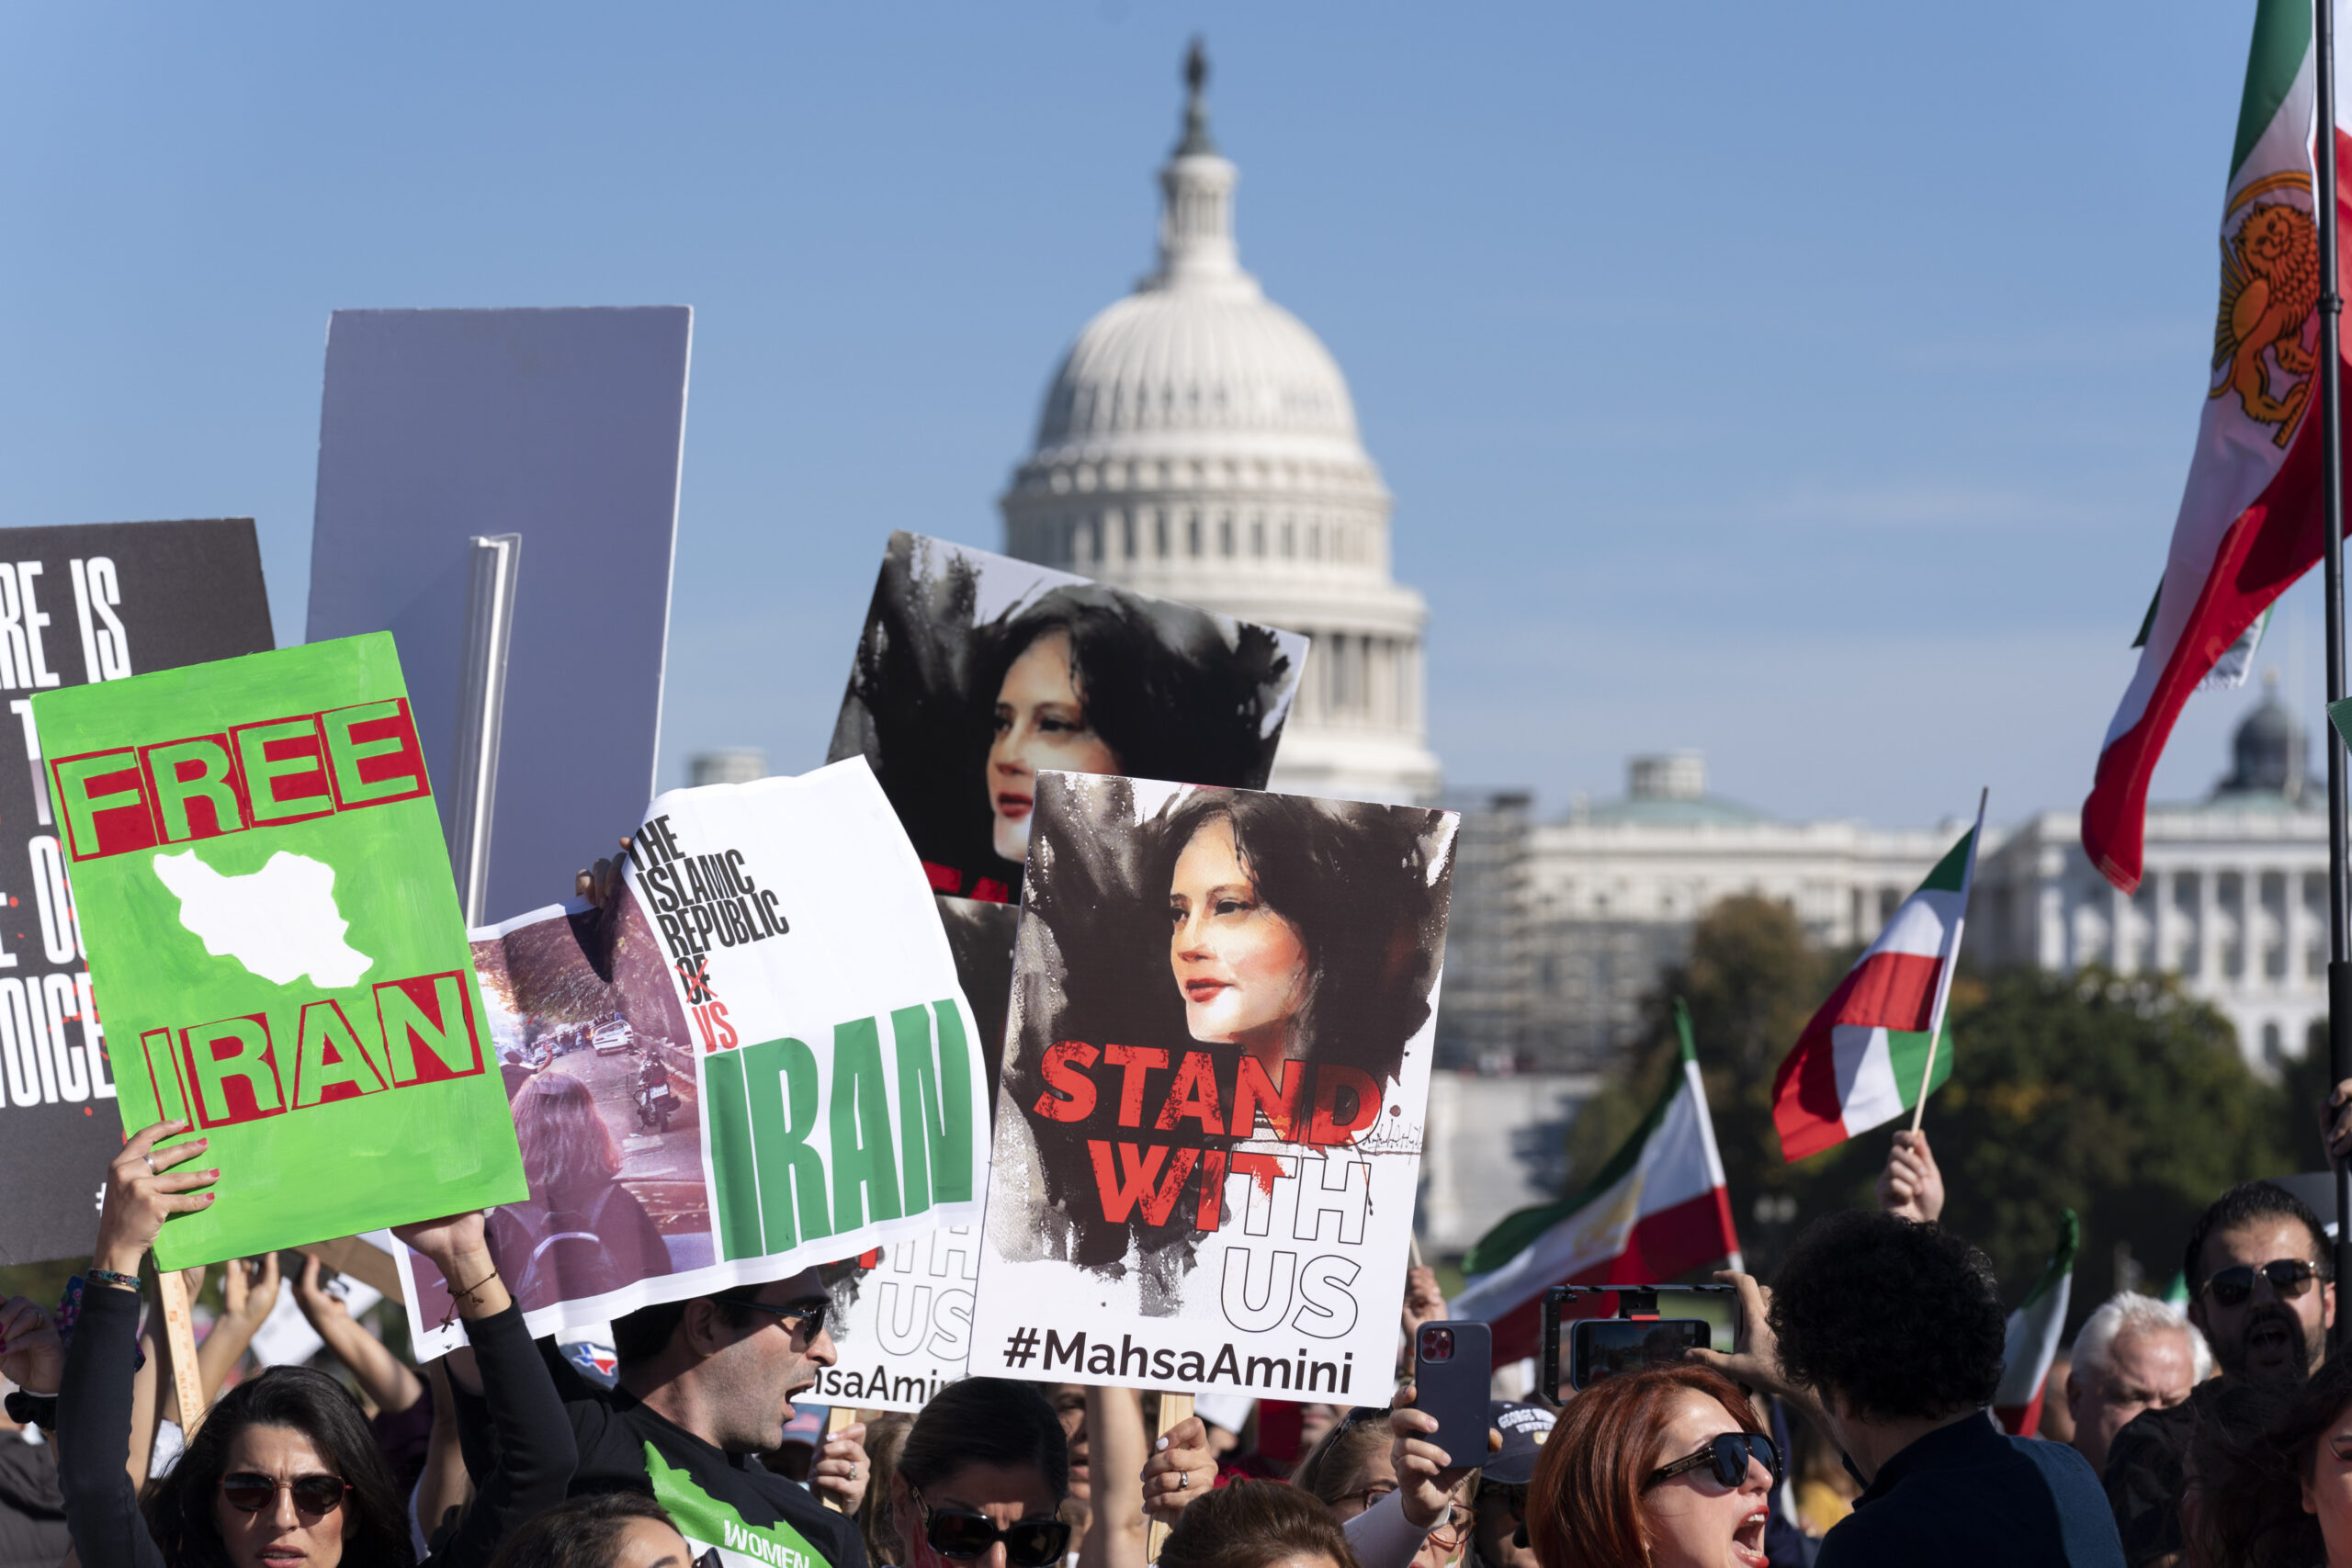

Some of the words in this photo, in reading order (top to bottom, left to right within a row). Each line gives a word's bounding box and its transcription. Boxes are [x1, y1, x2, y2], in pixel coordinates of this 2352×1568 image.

[69, 556, 132, 684] IS
[54, 699, 423, 858] FREE
[635, 849, 755, 915] ISLAMIC
[656, 889, 790, 959] REPUBLIC
[676, 953, 713, 1005] OF
[691, 1000, 739, 1054] VS
[0, 972, 118, 1108] OICE
[144, 976, 476, 1126] IRAN
[704, 998, 973, 1262] IRAN
[1033, 1040, 1383, 1147] STAND
[1087, 1139, 1372, 1245] WITH
[876, 1281, 977, 1361] US
[1221, 1247, 1362, 1339] US
[1002, 1326, 1353, 1394] #MahsaAmini
